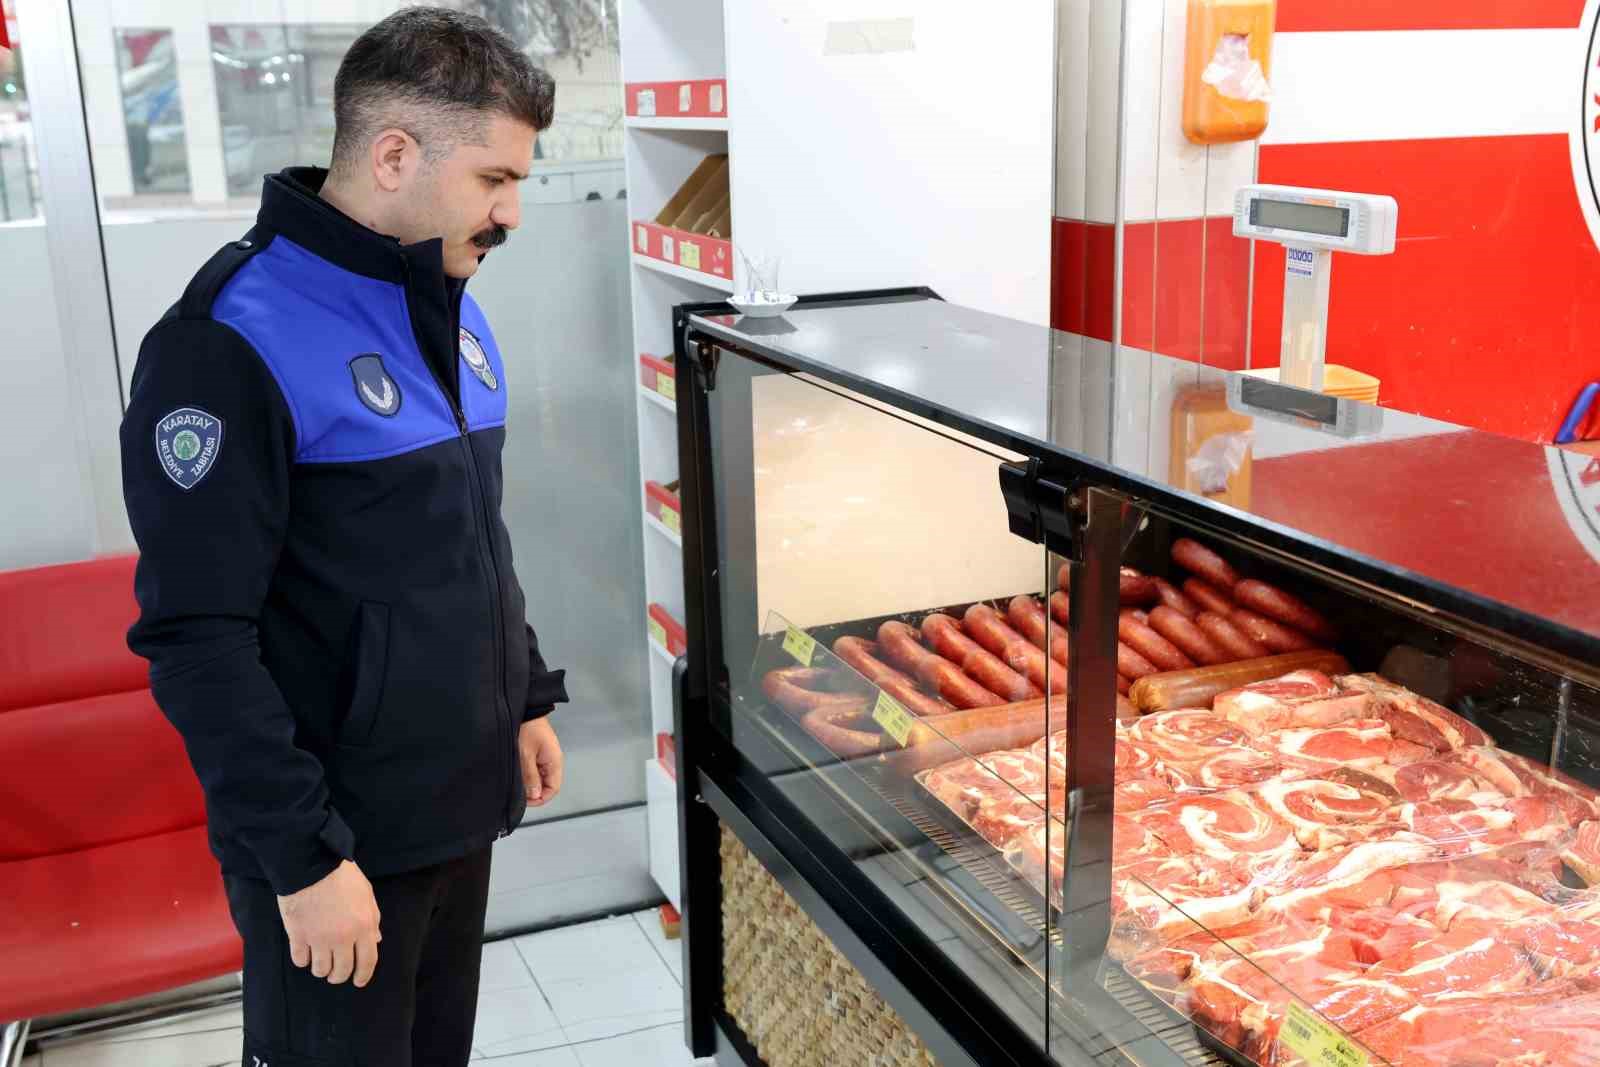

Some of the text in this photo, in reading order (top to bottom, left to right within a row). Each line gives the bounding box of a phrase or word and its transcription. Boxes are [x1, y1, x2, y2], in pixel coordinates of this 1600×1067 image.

[162, 415, 213, 433] KARATAY
[160, 439, 185, 479] BELEDİYE
[190, 437, 216, 477] ZABITASI
